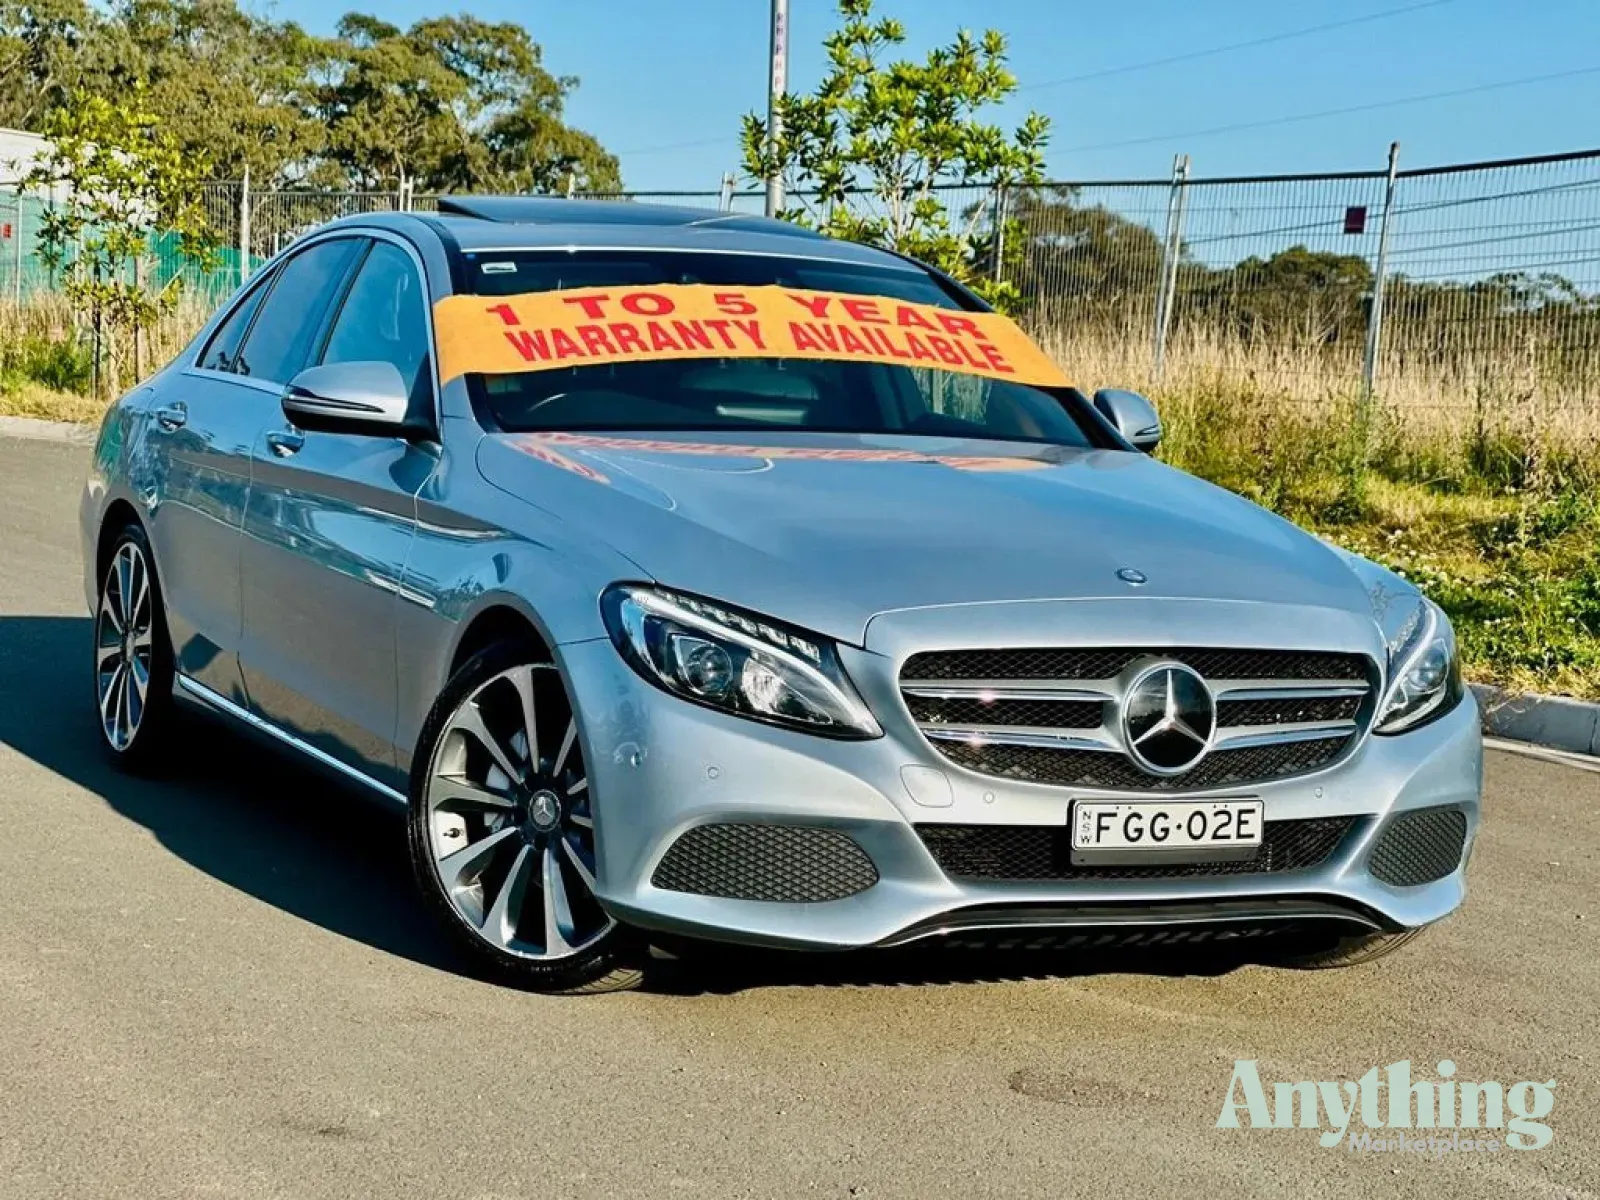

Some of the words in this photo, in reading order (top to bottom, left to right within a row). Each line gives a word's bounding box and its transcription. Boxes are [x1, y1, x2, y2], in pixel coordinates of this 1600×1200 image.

[486, 303, 520, 326] 1
[562, 292, 676, 319] TO
[713, 293, 757, 315] 5
[785, 293, 989, 340] YEAR
[503, 319, 767, 362] WARRANTY
[788, 321, 1016, 374] AVAILABLE
